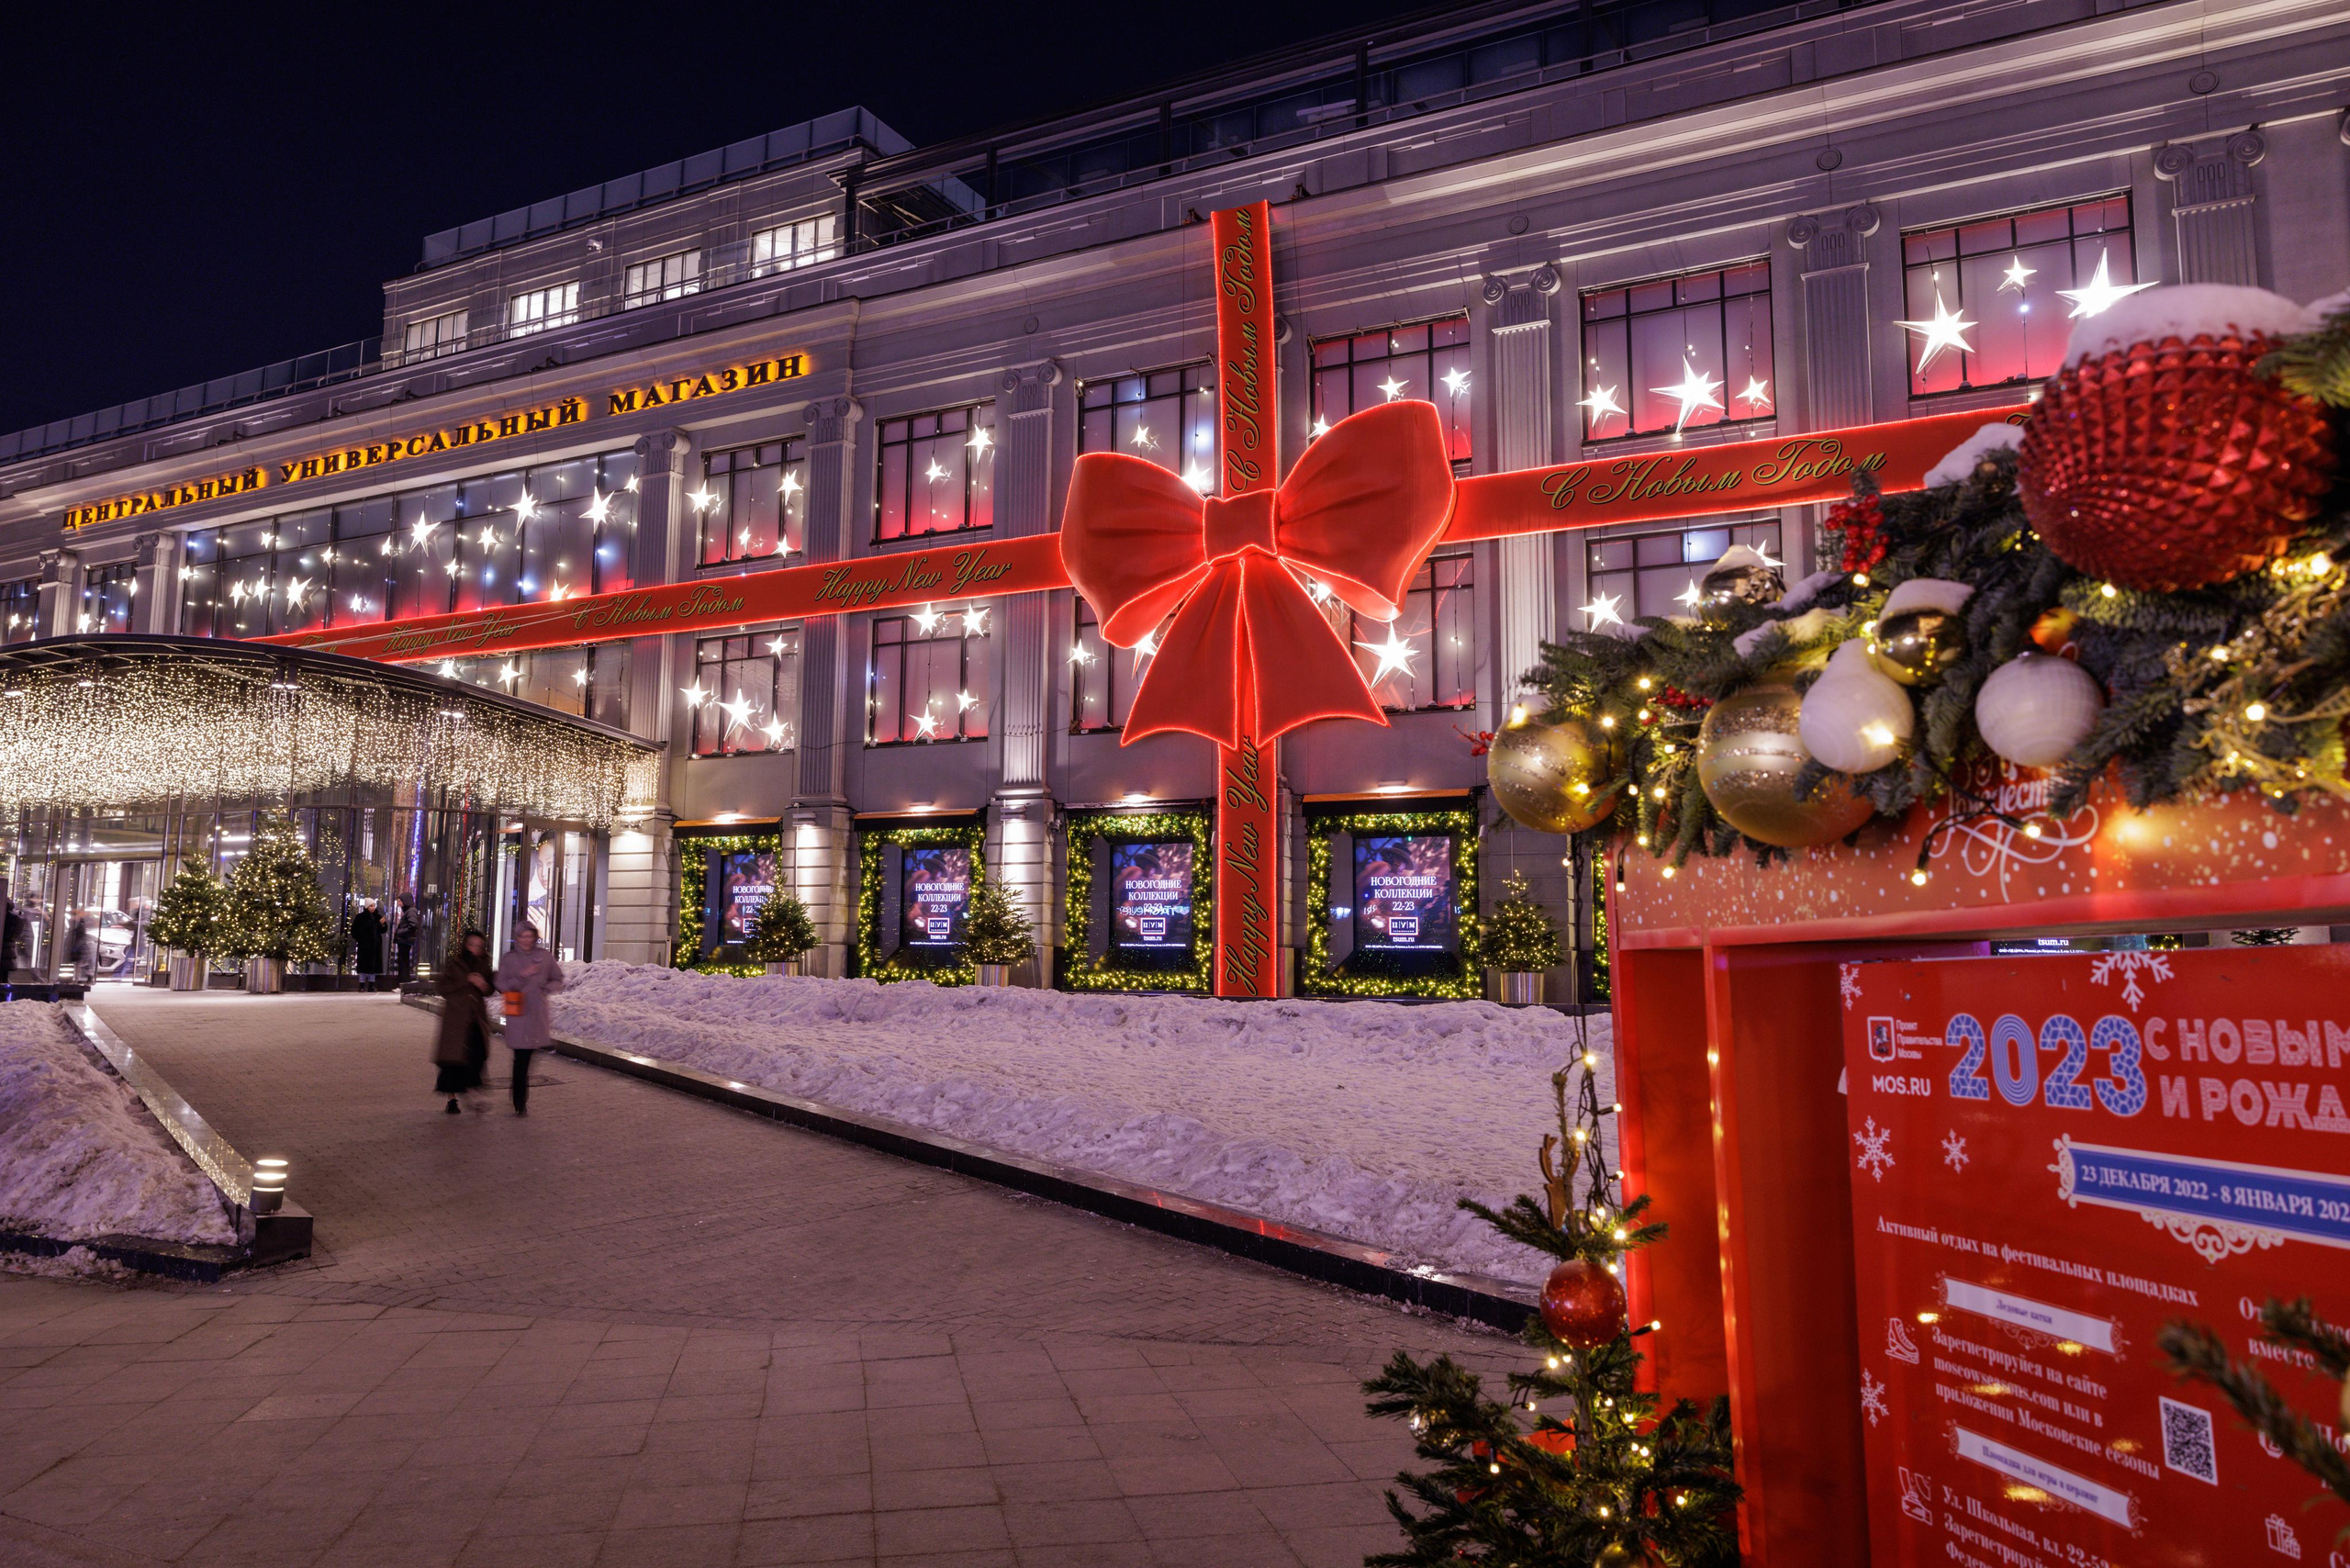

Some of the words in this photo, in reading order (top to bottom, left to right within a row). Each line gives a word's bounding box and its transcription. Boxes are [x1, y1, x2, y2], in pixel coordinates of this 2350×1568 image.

[1222, 207, 1258, 315] Годом
[1224, 321, 1261, 451] Новым
[62, 468, 260, 530] ЦЕНТРАЛЬНЫЙ
[280, 398, 582, 484] УНИВЕРСАЛЬНЫЙ
[608, 354, 804, 415] МАГАЗИН
[1228, 449, 1261, 492] С
[1540, 465, 1590, 510] С
[1586, 455, 1743, 504] Новым
[1751, 438, 1886, 487] Годом
[815, 566, 888, 607] Happy
[889, 556, 942, 592] New
[948, 550, 1013, 595] Year
[572, 599, 599, 631] С
[593, 594, 674, 627] Новым
[677, 585, 744, 617] Годом
[383, 623, 435, 658] Happy
[435, 617, 472, 644] New
[475, 612, 520, 647] Year
[1225, 735, 1270, 812] Year
[1225, 822, 1259, 893] New
[915, 882, 965, 892] НОВОГОДНИЕ
[918, 893, 961, 903] КОЛЛЕКЦИИ
[1125, 879, 1181, 890] НОВОГОДНИЕ
[1128, 891, 1179, 902] КОЛЛЕКЦИИ
[1371, 876, 1438, 888] НОВОГОДНИЕ
[1374, 889, 1433, 900] КОЛЛЕКЦИИ
[930, 904, 947, 913] 22-23
[1392, 901, 1415, 912] 22-23
[1225, 890, 1270, 996] Happy
[2038, 938, 2069, 946] tsum.ru
[2143, 1016, 2170, 1061] С
[1872, 1074, 1930, 1097] MOS.RU
[1945, 1013, 2148, 1117] 2023
[2159, 1074, 2190, 1119] И
[2081, 1165, 2098, 1182] 23
[2098, 1166, 2171, 1194] ДЕКАБРЯ
[2173, 1178, 2209, 1200] 2022
[2220, 1184, 2232, 1204] 8
[2233, 1186, 2314, 1216] ЯНВАРЯ
[1876, 1215, 1939, 1244] Активный
[1941, 1233, 1979, 1254] отдых
[1982, 1242, 1998, 1258] на
[2000, 1243, 2103, 1284] фестивальных
[2106, 1271, 2199, 1307] площадках
[1931, 1326, 2043, 1378] Зарегистрируйся
[2046, 1366, 2064, 1385] на
[2065, 1375, 2108, 1400] сайте
[1933, 1356, 2060, 1412] moscowseasons.com
[2063, 1401, 2091, 1423] или
[2093, 1412, 2103, 1428] в
[1935, 1382, 2015, 1424] приложении
[2018, 1406, 2102, 1457] Московские
[2104, 1446, 2160, 1480] сезоны
[1942, 1484, 1964, 1510] Ул.
[1965, 1495, 2040, 1550] Школьная,
[2042, 1536, 2065, 1559] вл.
